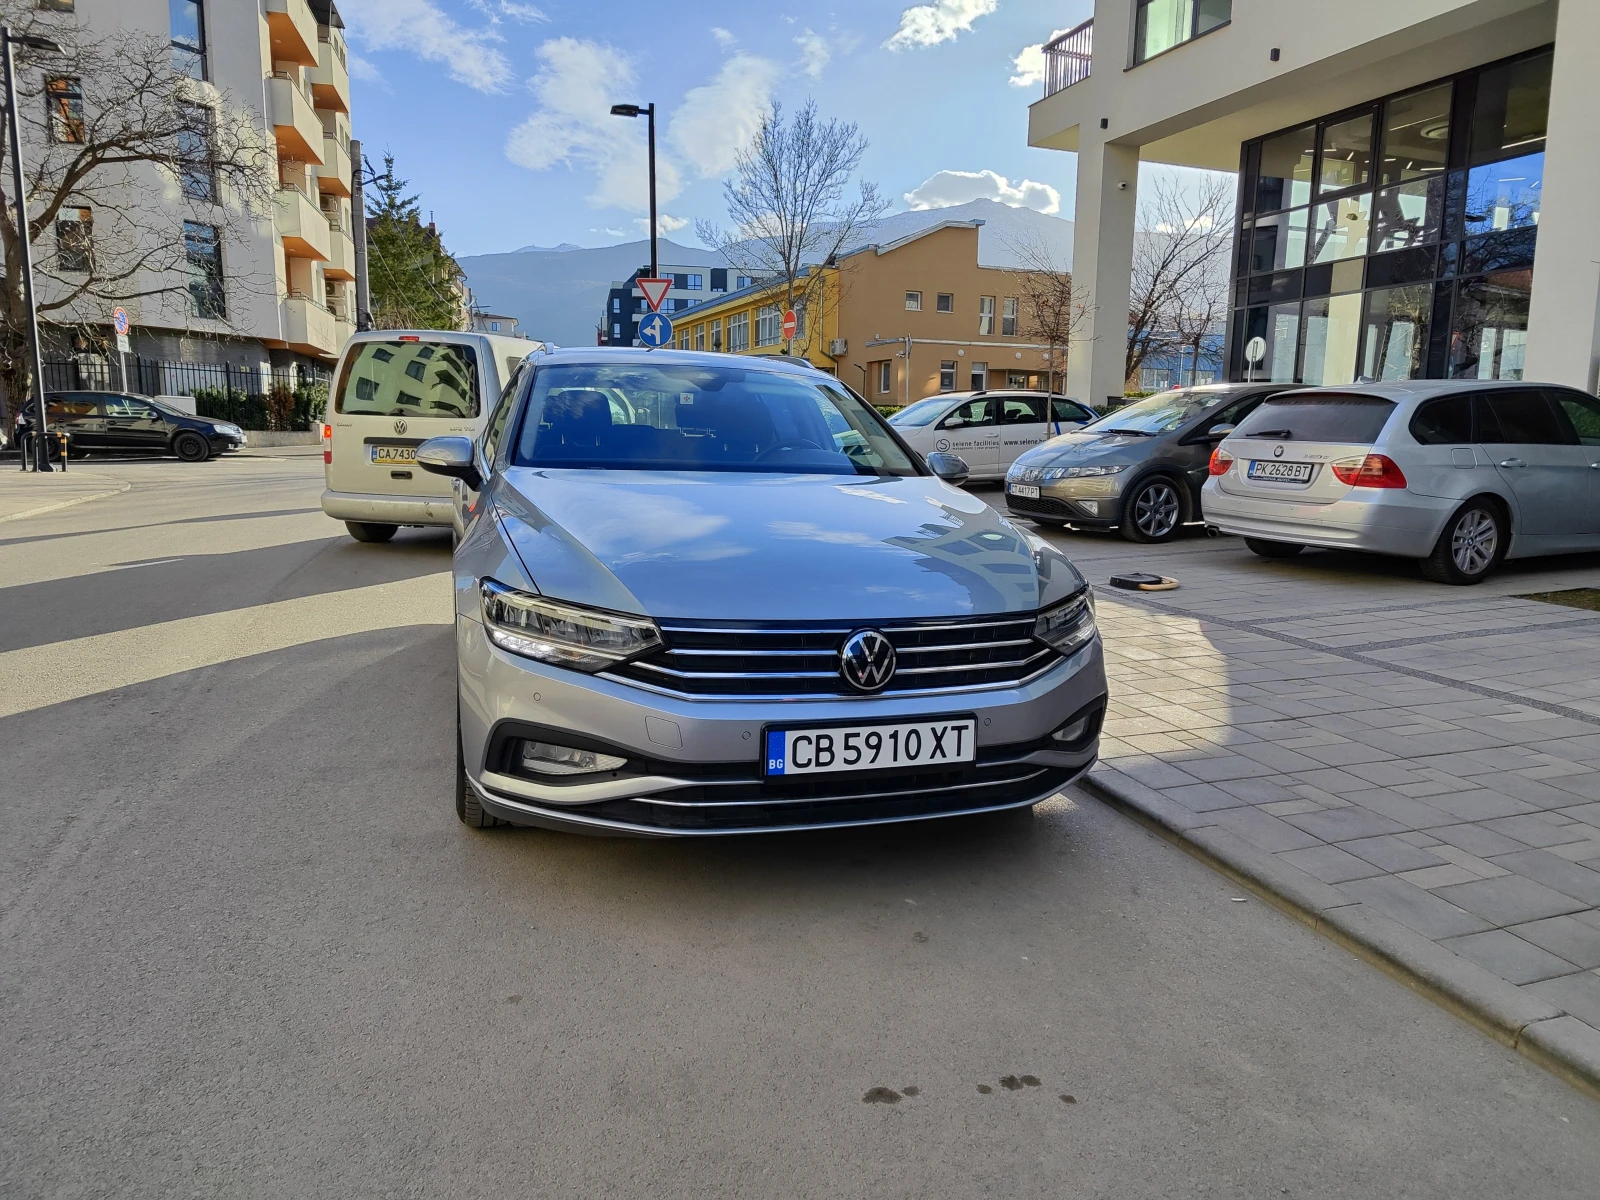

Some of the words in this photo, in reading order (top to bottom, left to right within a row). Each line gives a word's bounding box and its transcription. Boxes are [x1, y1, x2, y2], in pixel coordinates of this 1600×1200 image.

[1254, 463, 1269, 475] PK
[1269, 464, 1293, 476] 2628
[1294, 466, 1309, 477] BT
[1018, 486, 1030, 496] 4417
[1031, 487, 1038, 497] PT
[791, 734, 835, 768] CB
[843, 728, 922, 765] 5910
[929, 725, 969, 759] XT
[769, 759, 783, 769] BG
